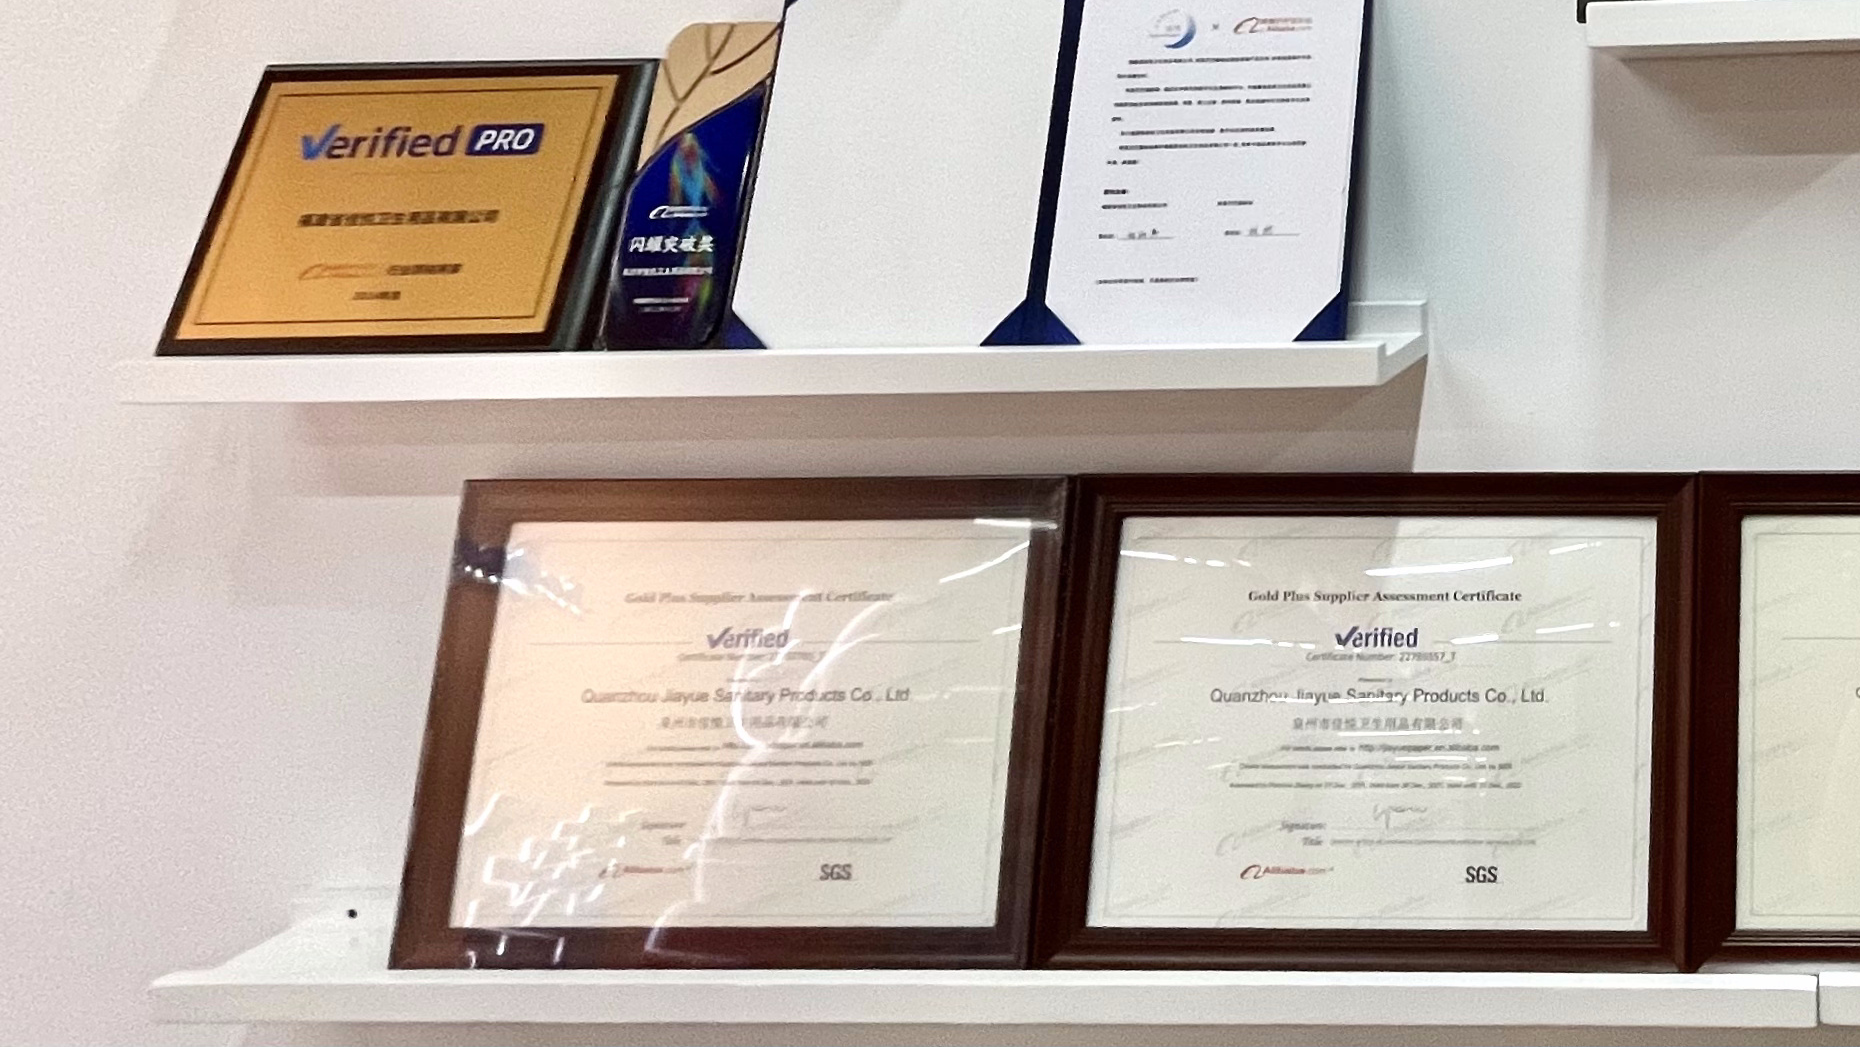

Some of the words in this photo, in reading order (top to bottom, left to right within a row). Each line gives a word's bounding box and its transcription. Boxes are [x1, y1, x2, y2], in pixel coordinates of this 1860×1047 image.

[301, 124, 465, 160] Verified
[474, 128, 535, 151] PRO
[1249, 591, 1279, 602] Gold
[1283, 591, 1309, 601] Plus
[1314, 591, 1369, 604] Supplier
[1374, 591, 1449, 601] Assessment
[1453, 590, 1522, 601] Certificate
[707, 627, 789, 649] Verified
[1335, 626, 1418, 648] Verified
[1413, 689, 1479, 702] Products
[820, 864, 852, 881] SGS
[1466, 866, 1498, 883] SGS
